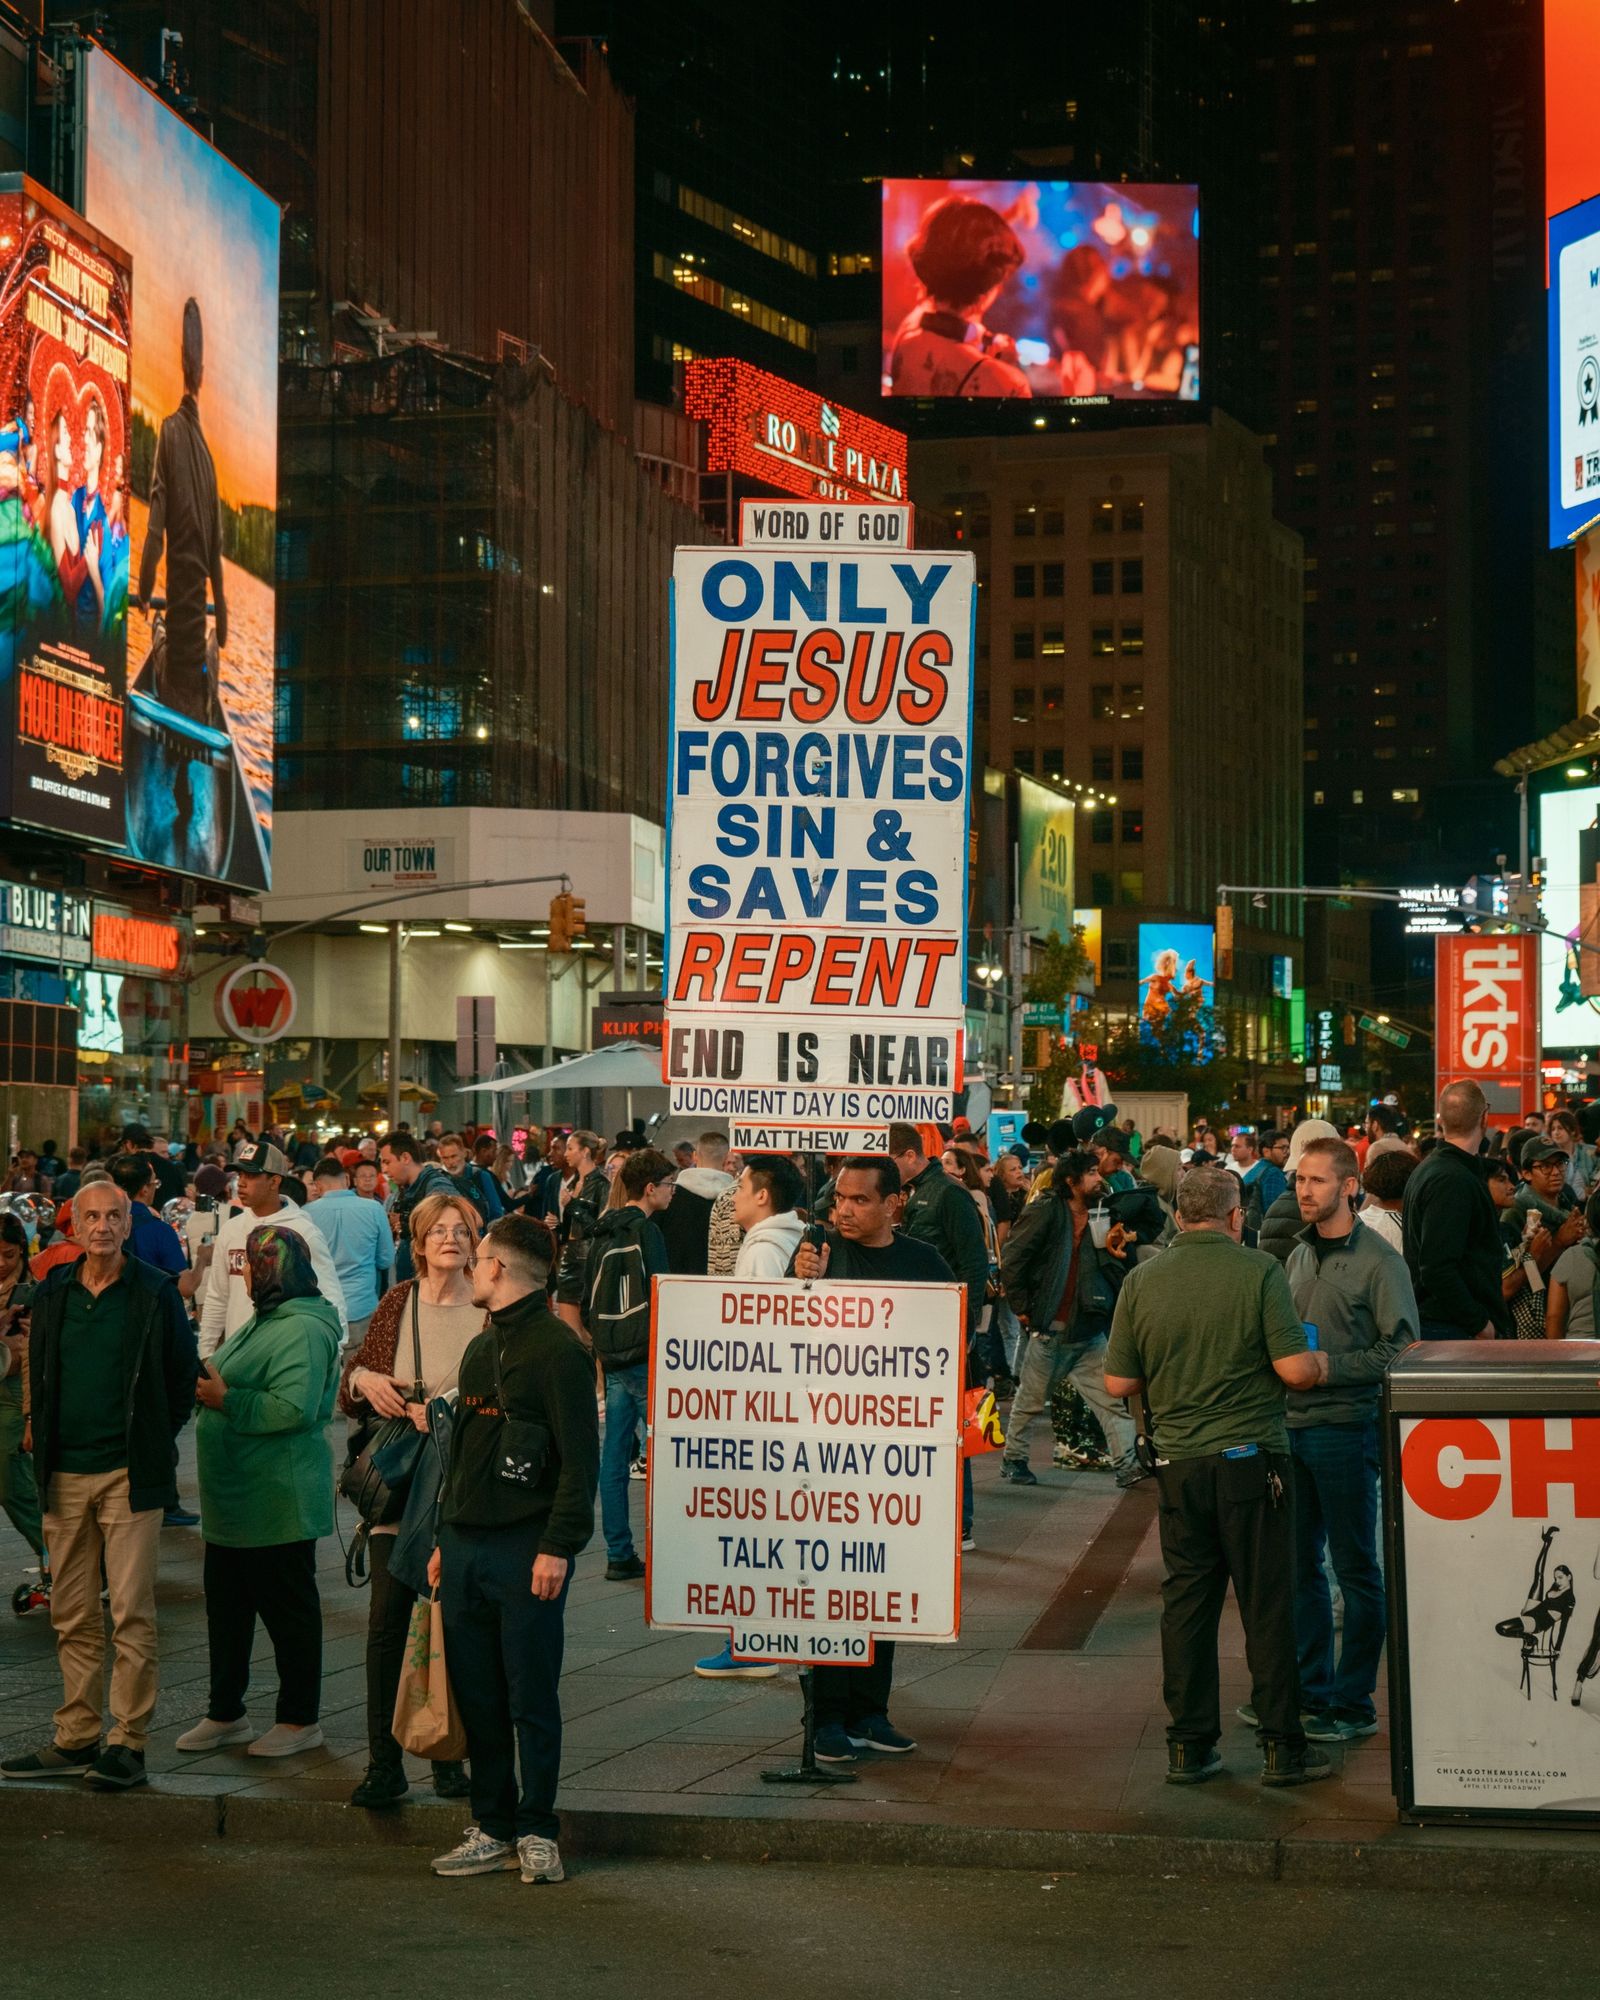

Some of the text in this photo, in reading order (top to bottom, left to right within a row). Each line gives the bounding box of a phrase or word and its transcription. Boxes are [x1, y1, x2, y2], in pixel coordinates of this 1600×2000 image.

[48, 249, 80, 300] AARON
[846, 448, 902, 498] PLAZA
[753, 510, 899, 541] WORD OF GOD
[702, 560, 952, 624] ONLY
[693, 628, 953, 726] JESUS
[19, 672, 73, 748] MOULIN
[74, 693, 123, 764] ROUGE!
[677, 731, 963, 802] FORGIVES
[716, 803, 916, 862] SIN &
[364, 847, 435, 872] OUR TOWN
[12, 885, 56, 931] BLUE
[688, 864, 939, 925] SAVES
[673, 931, 959, 1008] REPENT
[1462, 943, 1522, 1069] tkts
[602, 1022, 639, 1035] KLIK
[670, 1028, 948, 1086] END IS NEAR
[673, 1088, 948, 1121] JUDGMENT DAY IS COMING
[734, 1129, 888, 1151] MATTHEW 24
[721, 1293, 894, 1329] DEPRESSED?
[665, 1338, 949, 1378] SUICIDAL THOUGHTS?
[667, 1388, 944, 1428] DONT KILL YOURSELF
[671, 1437, 937, 1477] THERE IS A WAY OUT
[686, 1487, 921, 1526] JESUS LOVES YOU
[718, 1536, 885, 1573] TALK TO HIM
[687, 1584, 918, 1624] READ THE BIBLE!
[734, 1633, 865, 1657] JOHN 10:10
[1437, 1768, 1567, 1777] CHICAGOTHEMUSICAL.COM
